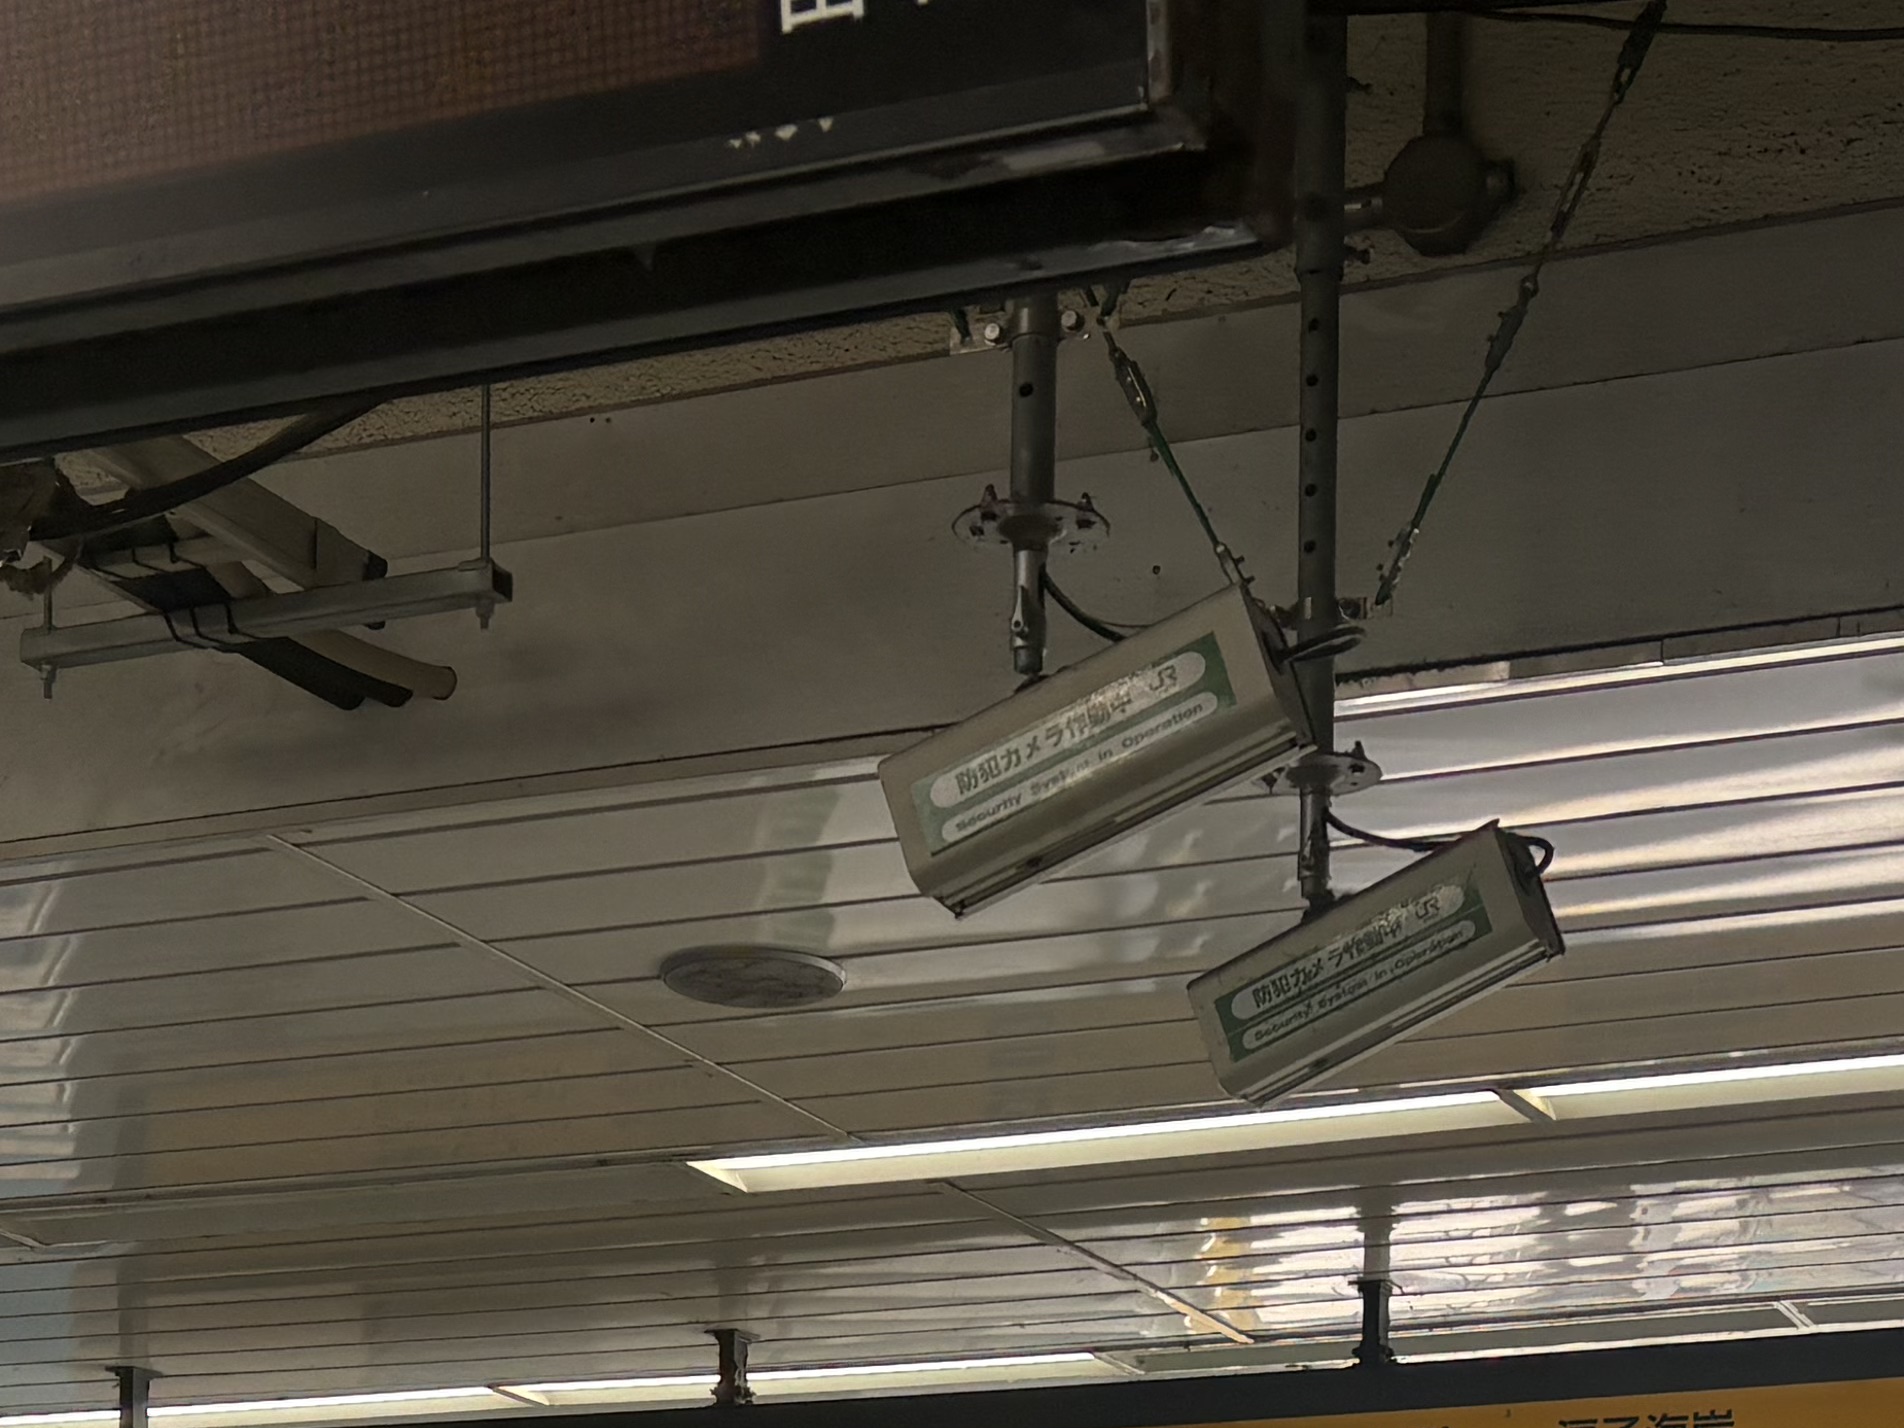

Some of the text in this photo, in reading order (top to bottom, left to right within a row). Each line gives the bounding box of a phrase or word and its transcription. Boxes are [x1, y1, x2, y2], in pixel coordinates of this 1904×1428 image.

[955, 690, 1133, 797] 防犯カメラ作動中
